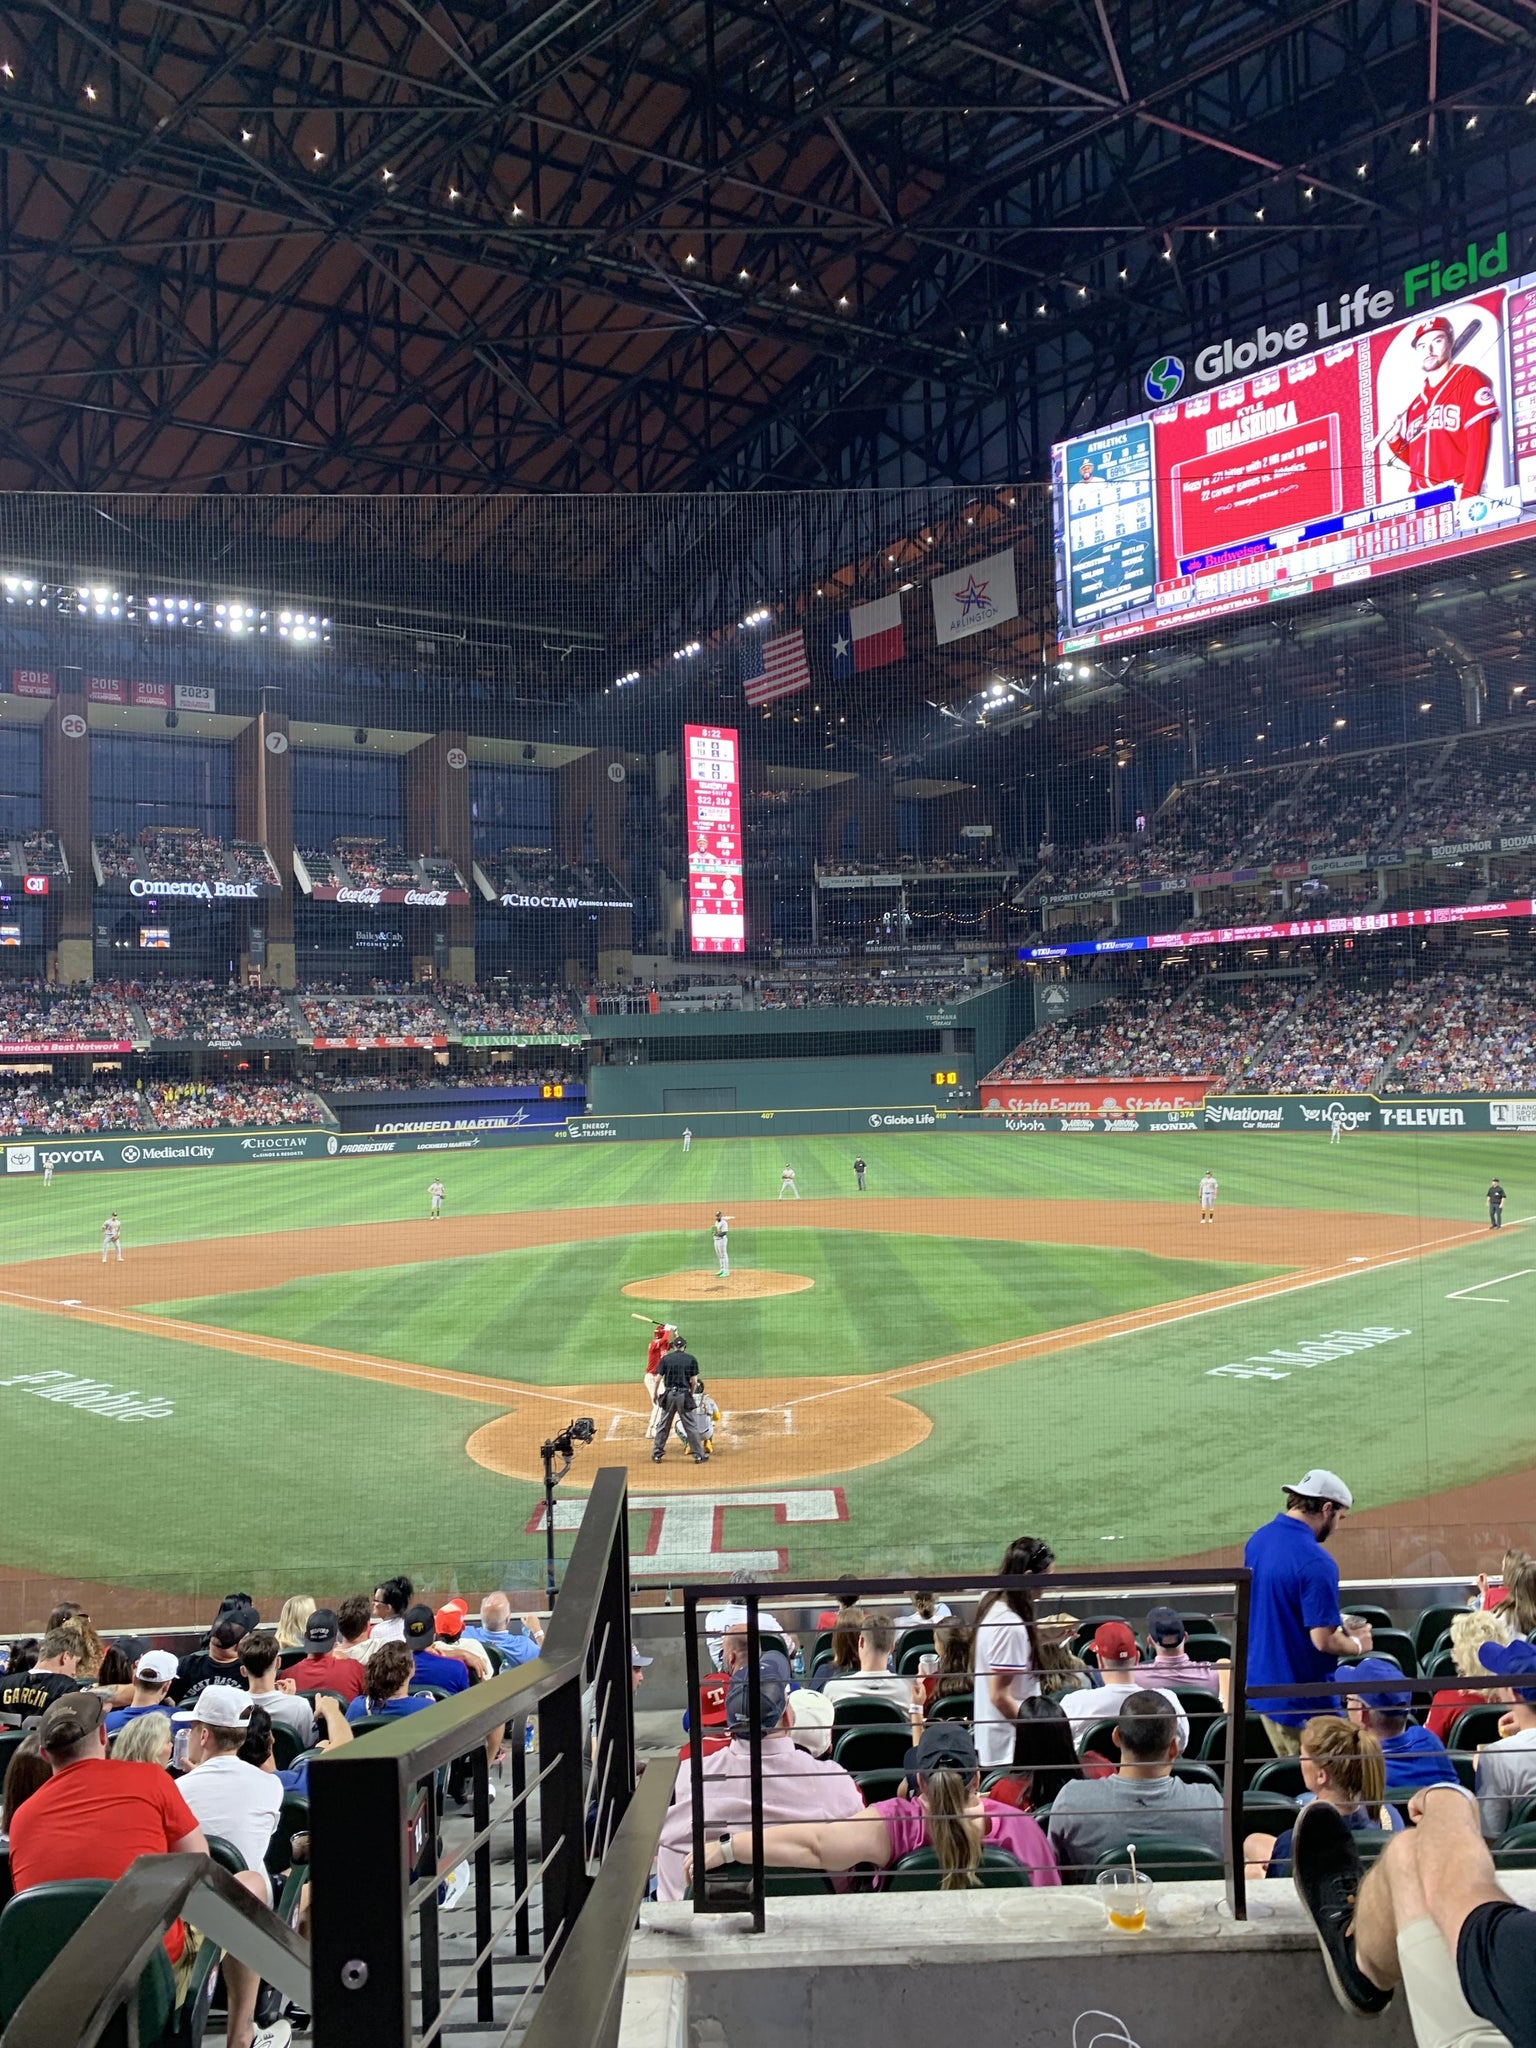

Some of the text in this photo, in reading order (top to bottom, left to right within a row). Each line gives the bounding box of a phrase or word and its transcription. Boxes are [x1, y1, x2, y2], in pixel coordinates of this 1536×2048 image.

[1194, 231, 1508, 382] Globe Life Field
[1236, 401, 1265, 418] KYLE
[1205, 400, 1298, 453] HIGASHIOKA
[1087, 434, 1128, 453] ATHLETICS
[1281, 449, 1295, 462] and
[1211, 484, 1236, 498] career
[1236, 476, 1260, 492] games
[1205, 544, 1266, 567] Budweiser
[1210, 595, 1260, 615] FASTBALL
[950, 607, 998, 631] ARLINGTON
[1123, 624, 1144, 636] MPH
[20, 671, 49, 685] 2012
[91, 678, 119, 691] 2015
[138, 682, 165, 695] 2016
[181, 686, 209, 699] 2023
[64, 719, 84, 733] 26
[702, 729, 721, 738] 8:22
[273, 736, 281, 749] 7
[449, 752, 465, 765] 29
[610, 767, 622, 778] 10
[697, 796, 730, 806] $22,310
[1431, 840, 1492, 857] BODYARMOR
[1311, 859, 1363, 872] GoPGL.com
[1377, 854, 1402, 864] PGL
[1282, 866, 1305, 876] PGL
[26, 878, 46, 892] QT
[214, 881, 258, 897] Bank
[1160, 879, 1186, 890] 105.3
[507, 893, 579, 908] CHOCTAW
[1050, 888, 1115, 903] PRIORITY COMMERCE
[1451, 903, 1507, 914] HIGASHIOKA
[1234, 925, 1273, 935] SEVERINO
[783, 946, 850, 955] PRIORITY GOLD
[955, 941, 1006, 951] PLUCKERS
[207, 1039, 243, 1047] ARENA
[413, 1036, 434, 1044] DEX
[476, 1034, 579, 1046] LUXOR STAFFING
[0, 1042, 119, 1052] America's Best Network
[883, 1114, 935, 1124] Globe Life
[1221, 1106, 1283, 1121] National
[1322, 1102, 1371, 1131] Kroger
[375, 1115, 509, 1133] LOCKHEED MARTIN
[582, 1122, 610, 1130] ENERGY
[1005, 1119, 1046, 1131] Kubota
[1150, 1123, 1198, 1131] HONDA
[1256, 1121, 1280, 1129] Rental
[582, 1129, 617, 1137] TRANSFER
[247, 1137, 308, 1149] CHOCTAW
[340, 1142, 397, 1154] PROGRESSIVE
[417, 1141, 472, 1150] LOCKHEED MARTIN
[39, 1150, 104, 1164] TOYOTA
[142, 1146, 215, 1160] Medical City
[3, 1686, 48, 1708] GARCÍA
